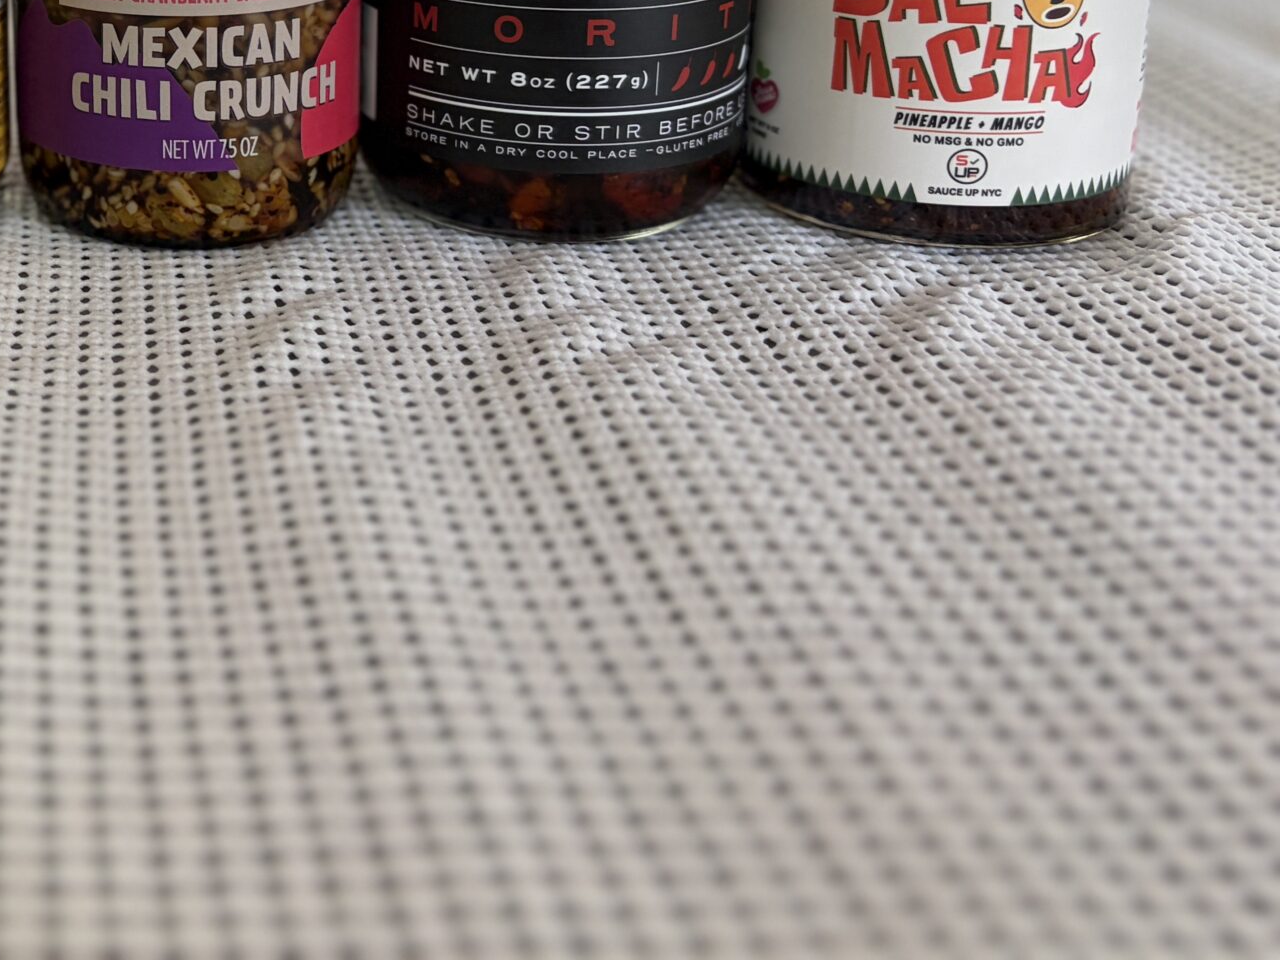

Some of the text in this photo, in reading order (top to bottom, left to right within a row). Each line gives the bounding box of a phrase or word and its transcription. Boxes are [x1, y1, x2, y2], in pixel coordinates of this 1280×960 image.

[101, 18, 301, 70] MEXICAN
[831, 16, 1073, 104] MACHA
[408, 55, 449, 76] NET
[461, 66, 496, 83] WT
[566, 71, 649, 92] (227g)
[71, 72, 170, 121] CHILI
[193, 60, 336, 121] CRUNCH
[407, 103, 495, 135] SHAKE
[514, 123, 554, 140] OR
[574, 124, 641, 141] STIR
[659, 100, 734, 136] BEFORE
[894, 112, 1045, 130] PINEAPPLE + MANGO
[162, 136, 259, 159] NET WT 7.5 OZ
[405, 127, 447, 145] STORE
[454, 139, 469, 150] IN
[477, 144, 487, 152] A
[495, 146, 527, 156] DRY
[535, 150, 578, 159] COOL
[587, 149, 637, 159] PLACE
[707, 126, 729, 143] FREE
[913, 134, 1024, 146] NO MSG & NO GMO
[955, 167, 979, 178] UP
[928, 186, 962, 196] SAUCE
[981, 189, 1001, 197] NYC
